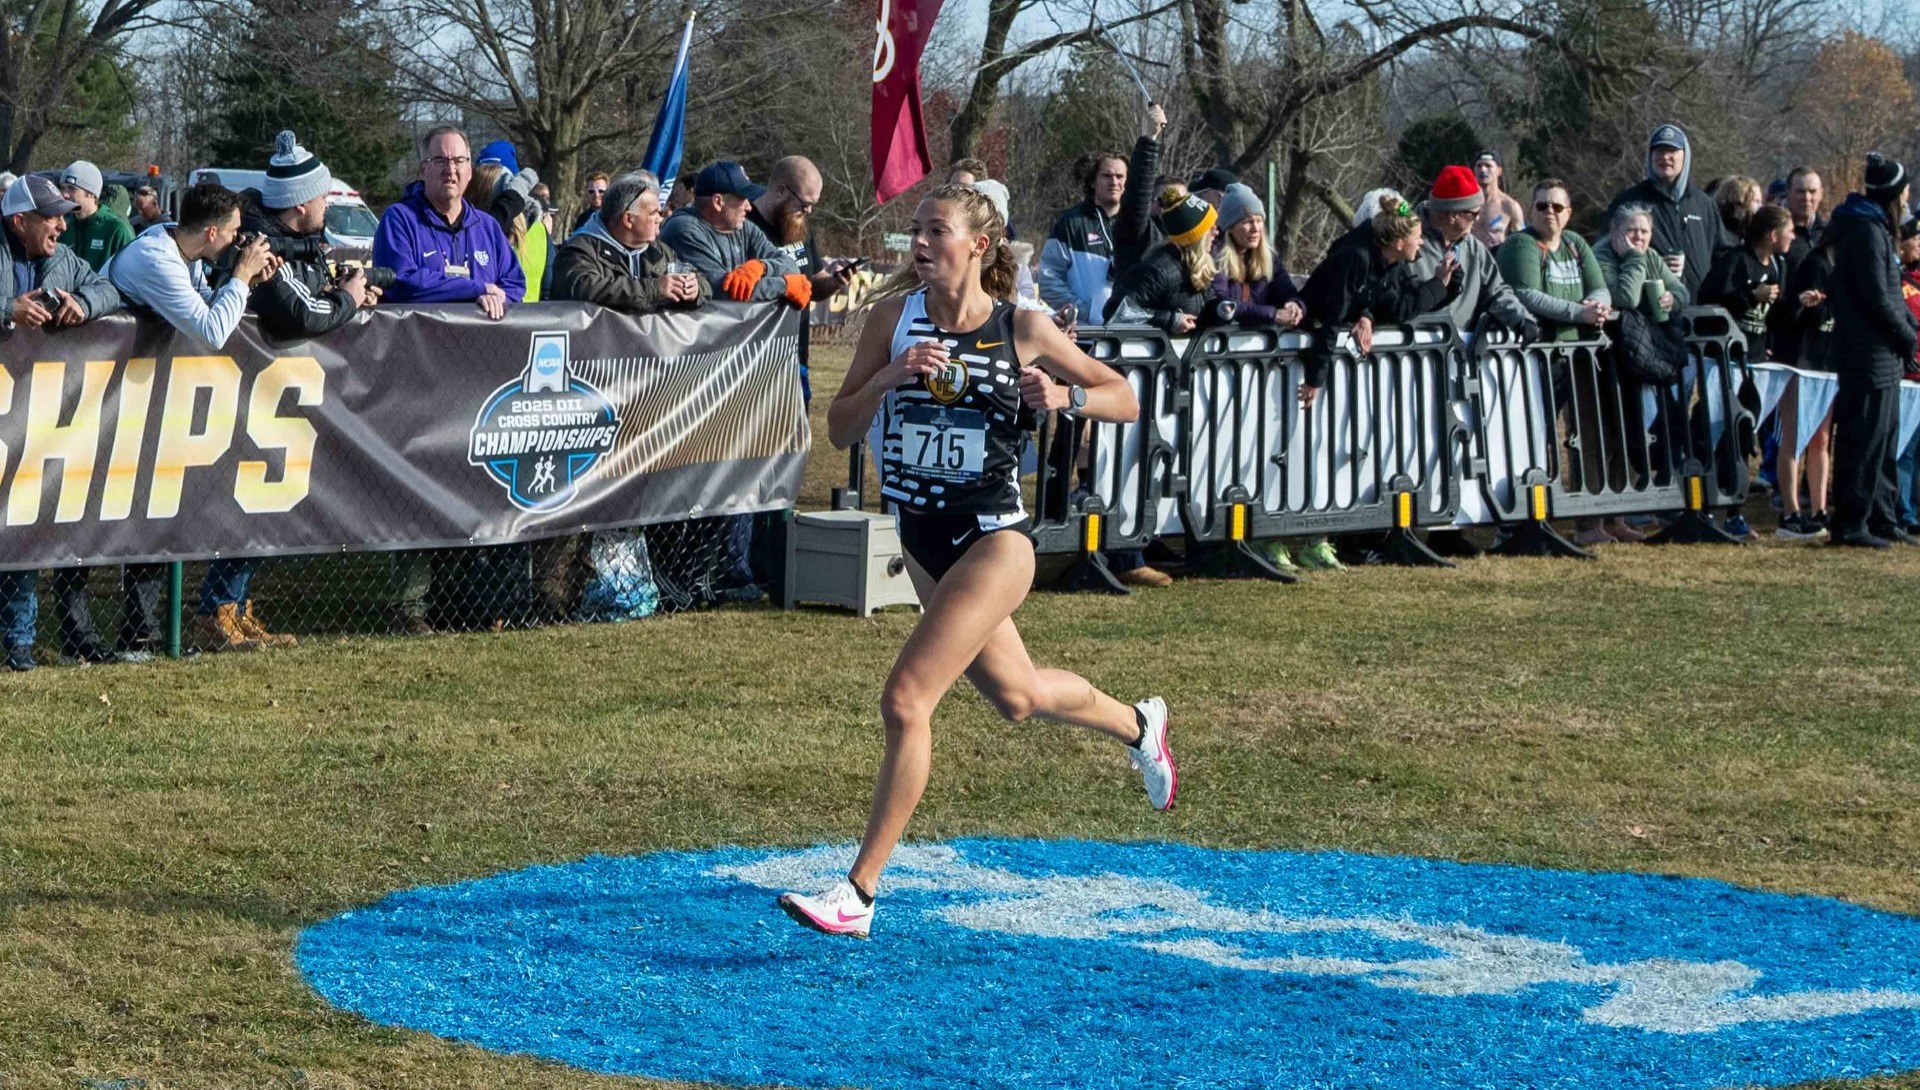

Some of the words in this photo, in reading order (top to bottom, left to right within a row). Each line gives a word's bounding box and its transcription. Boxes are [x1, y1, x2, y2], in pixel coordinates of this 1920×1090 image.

[537, 357, 561, 369] NCAA
[511, 400, 552, 413] 2025
[556, 399, 582, 412] DII
[498, 414, 540, 429] CROSS
[542, 412, 598, 427] COUNTRY
[0, 356, 326, 527] HIPS
[474, 426, 616, 456] CHAMPIONSHIPS
[916, 430, 966, 469] 715
